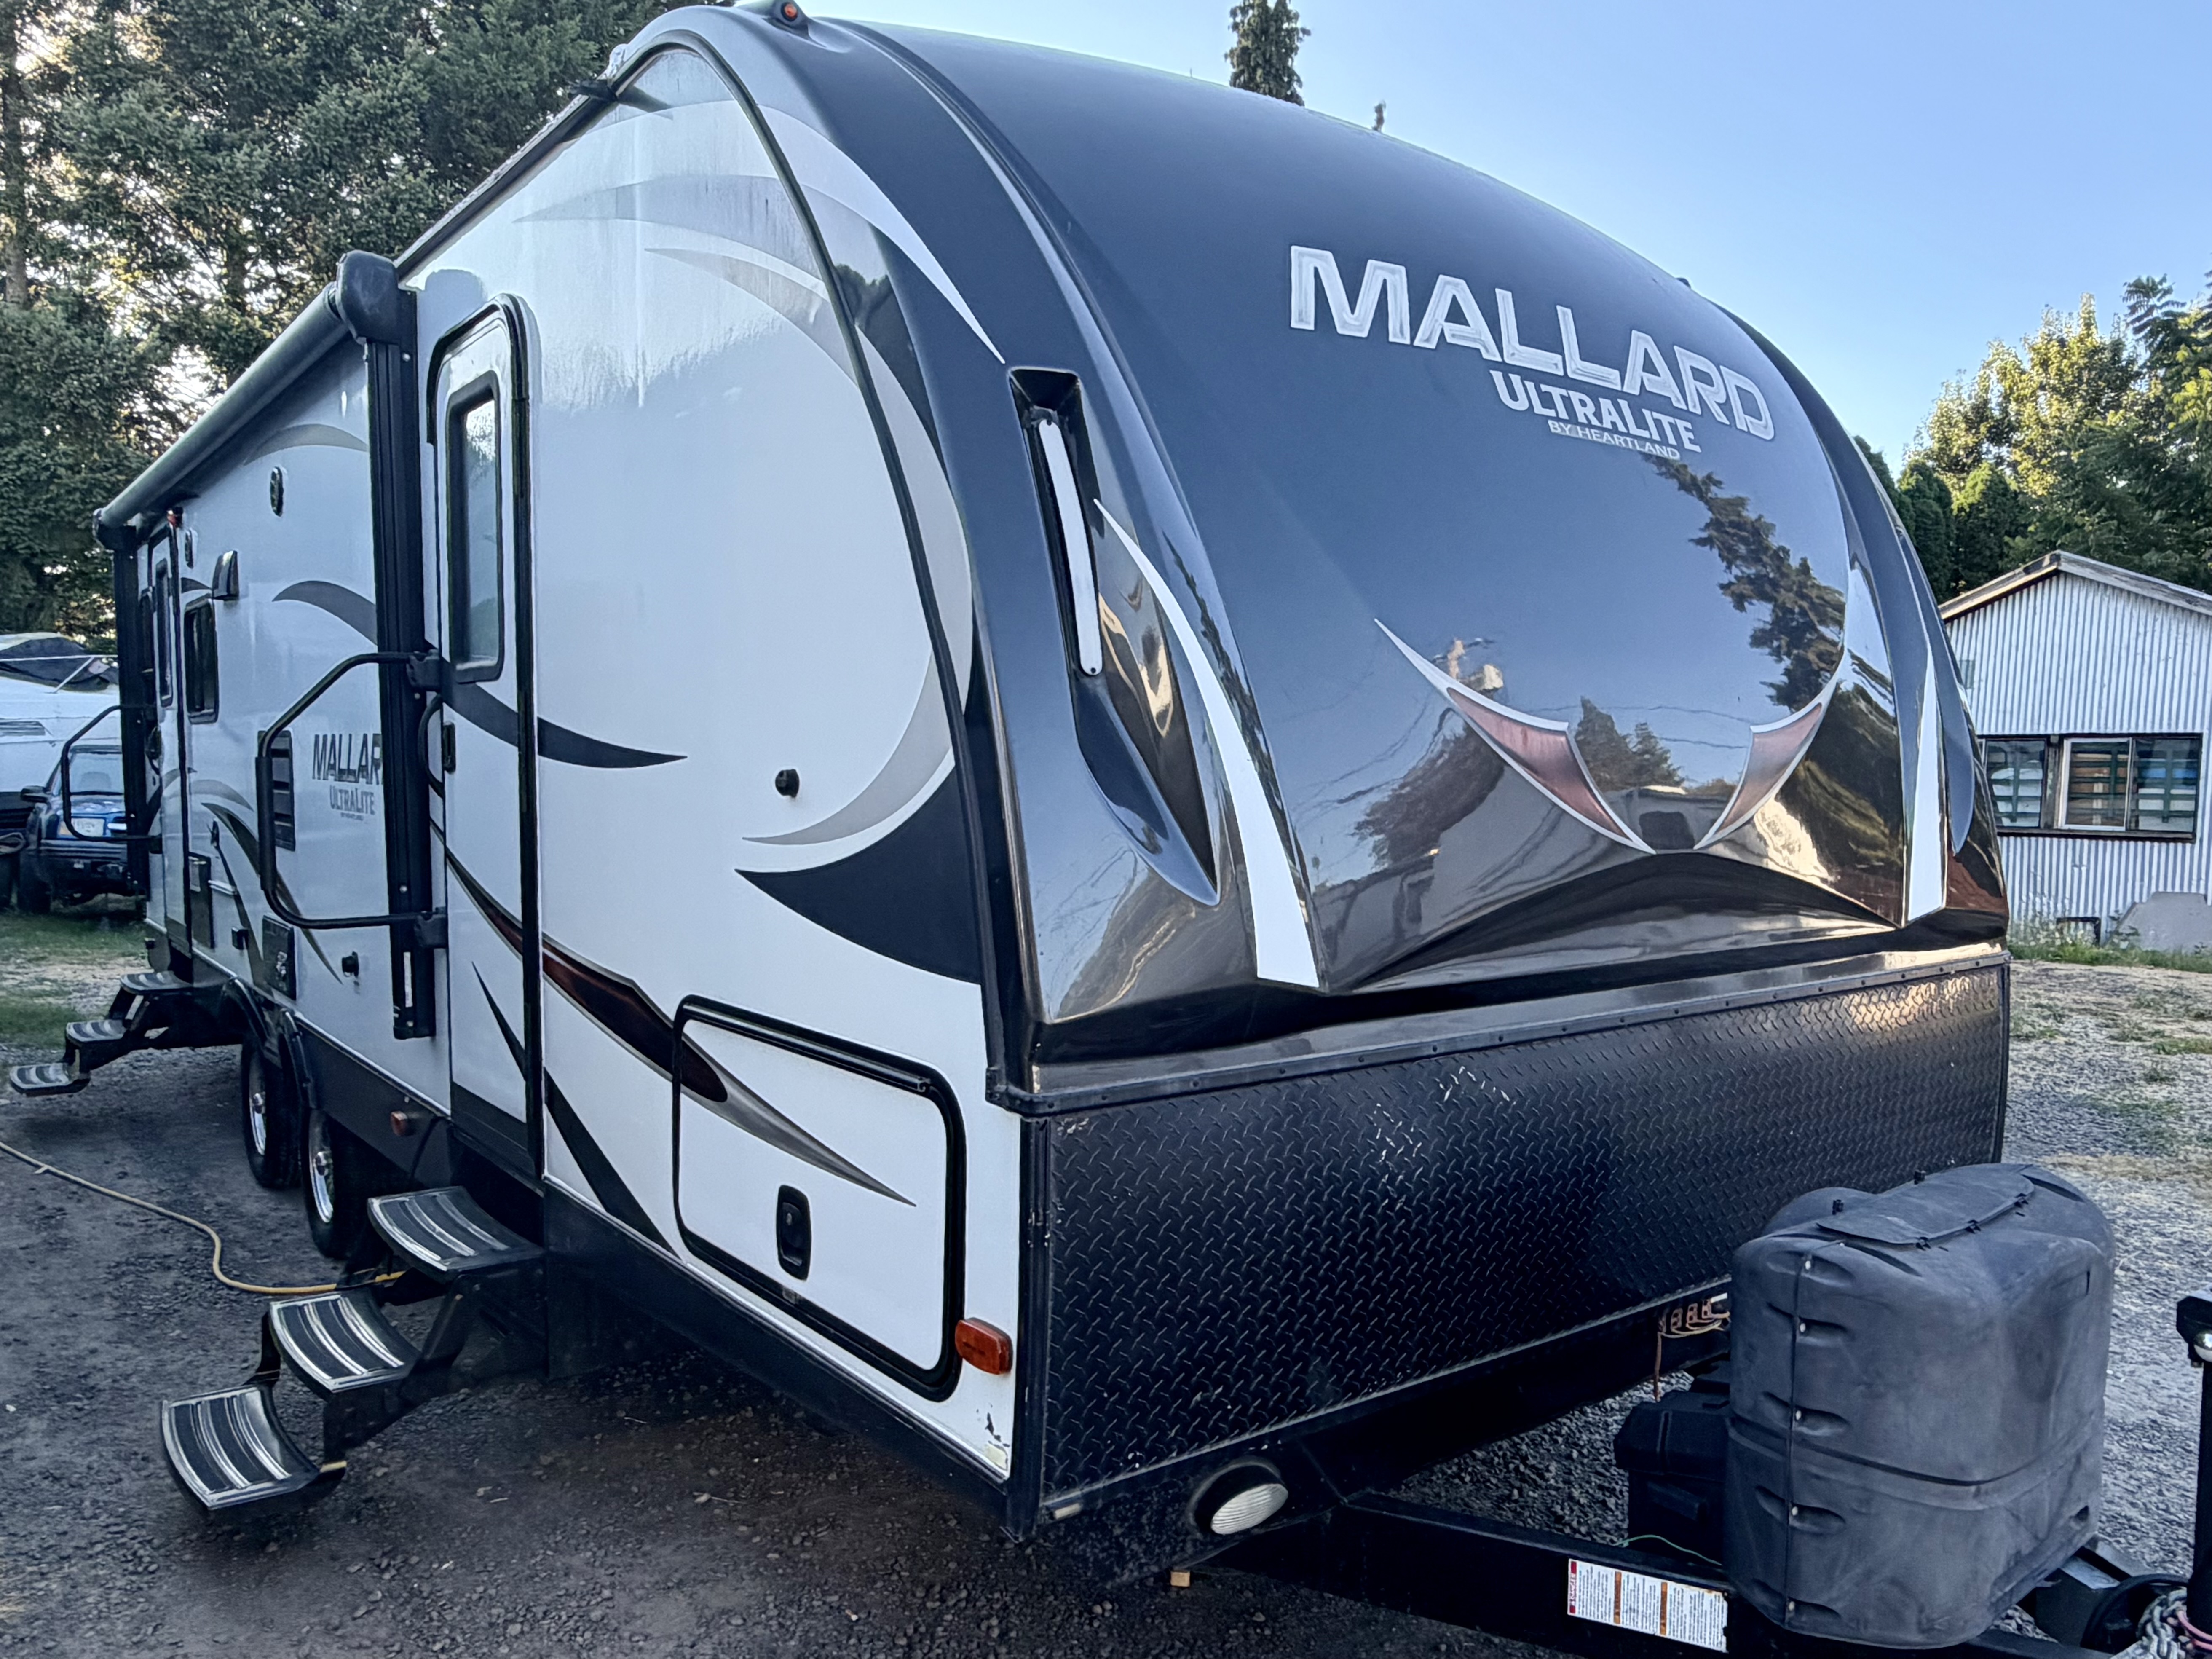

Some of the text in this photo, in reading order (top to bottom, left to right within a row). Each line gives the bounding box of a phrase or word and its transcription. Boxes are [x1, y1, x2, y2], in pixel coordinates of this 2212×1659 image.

[1290, 245, 1775, 440] MALLARD
[1489, 369, 1702, 453] ULTRALITE
[1547, 419, 1681, 461] BY HEARTLAND
[313, 734, 383, 785] MALLAR
[330, 785, 375, 815] ULTRALITE
